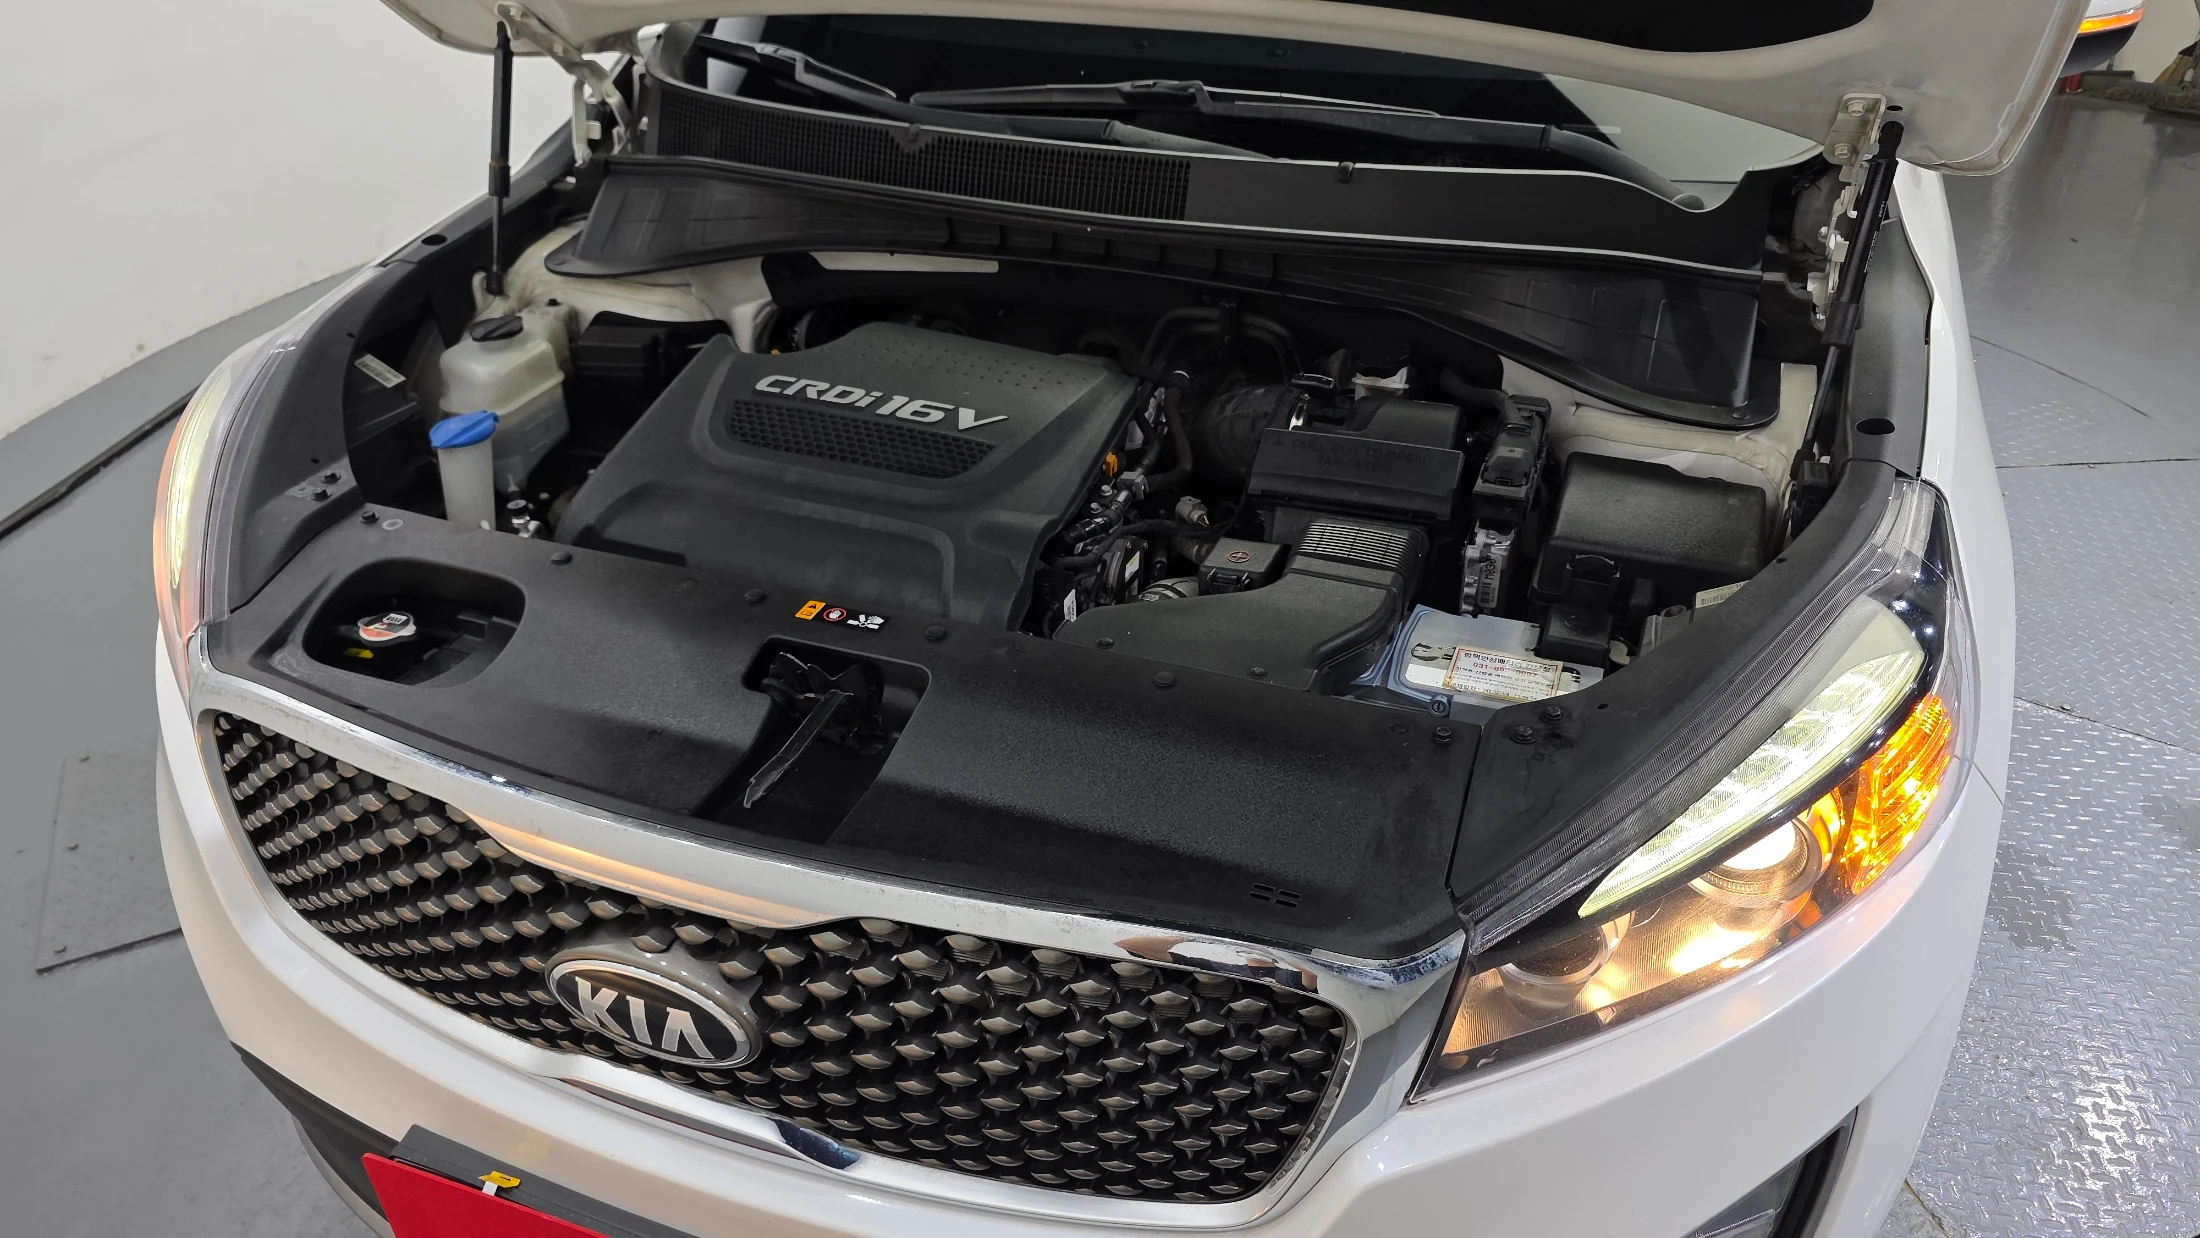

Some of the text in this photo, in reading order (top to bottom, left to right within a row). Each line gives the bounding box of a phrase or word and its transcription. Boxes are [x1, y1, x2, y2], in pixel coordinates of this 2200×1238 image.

[755, 375, 1009, 430] CRDi 16V
[1291, 439, 1325, 455] PULL
[1330, 443, 1360, 456] OUT
[575, 976, 715, 1059] KIA
